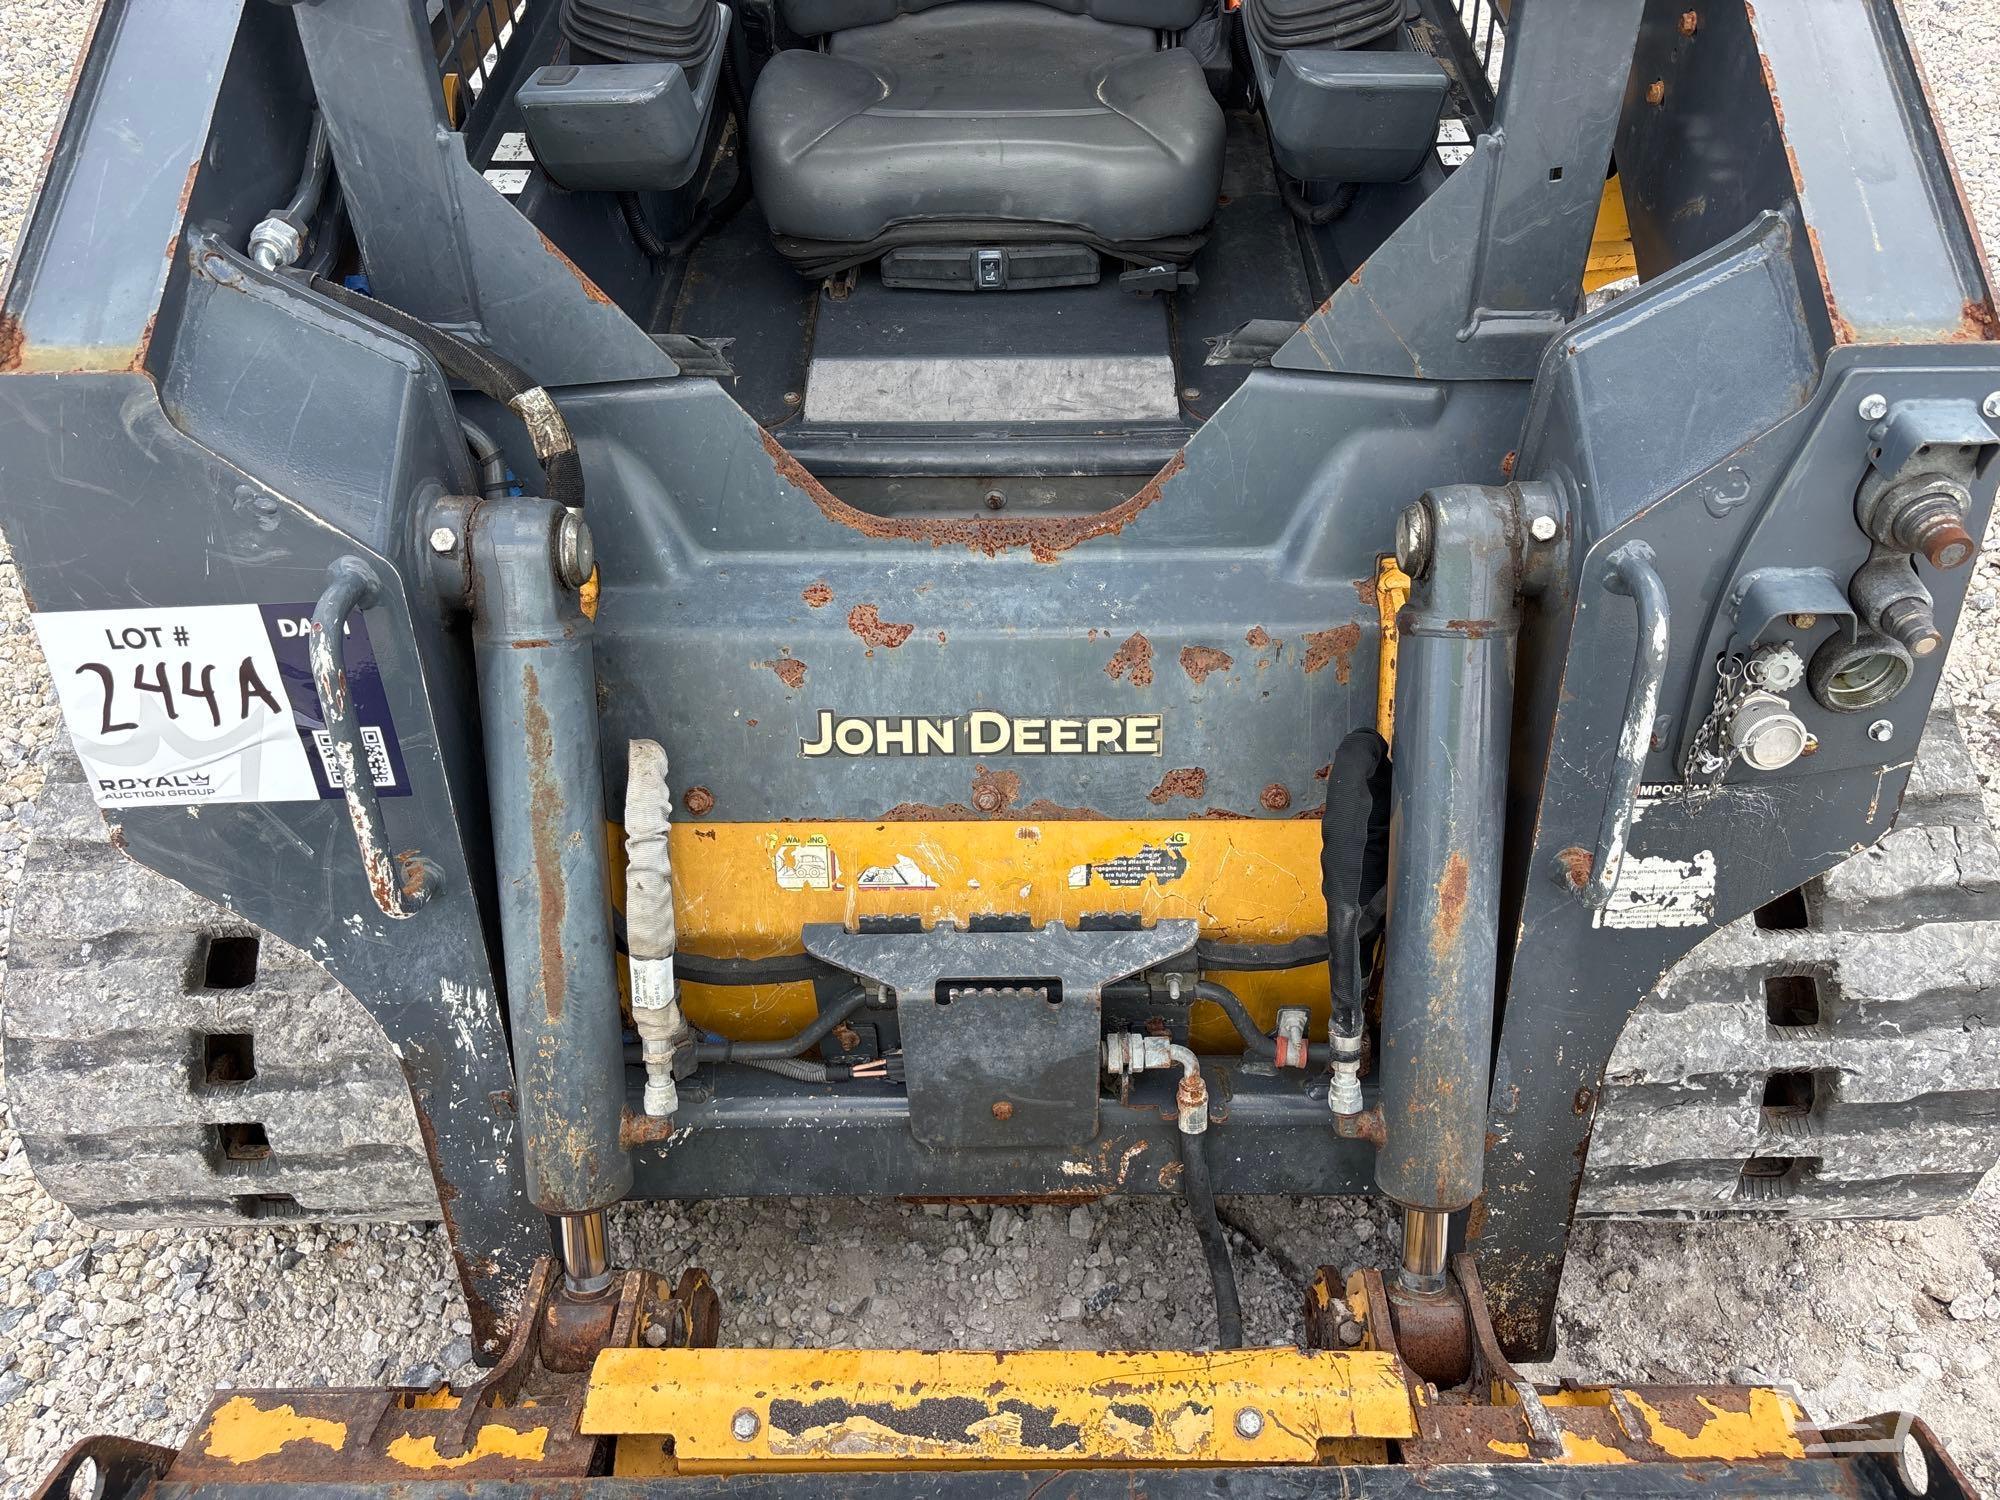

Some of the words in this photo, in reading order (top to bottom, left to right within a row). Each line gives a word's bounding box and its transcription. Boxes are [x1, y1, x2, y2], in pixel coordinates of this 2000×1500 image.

[105, 626, 162, 650] LOT
[173, 626, 190, 647] #
[75, 656, 282, 735] 244A
[98, 775, 189, 791] ROYAL
[104, 789, 166, 800] AUCTION
[167, 788, 216, 798] GROUP
